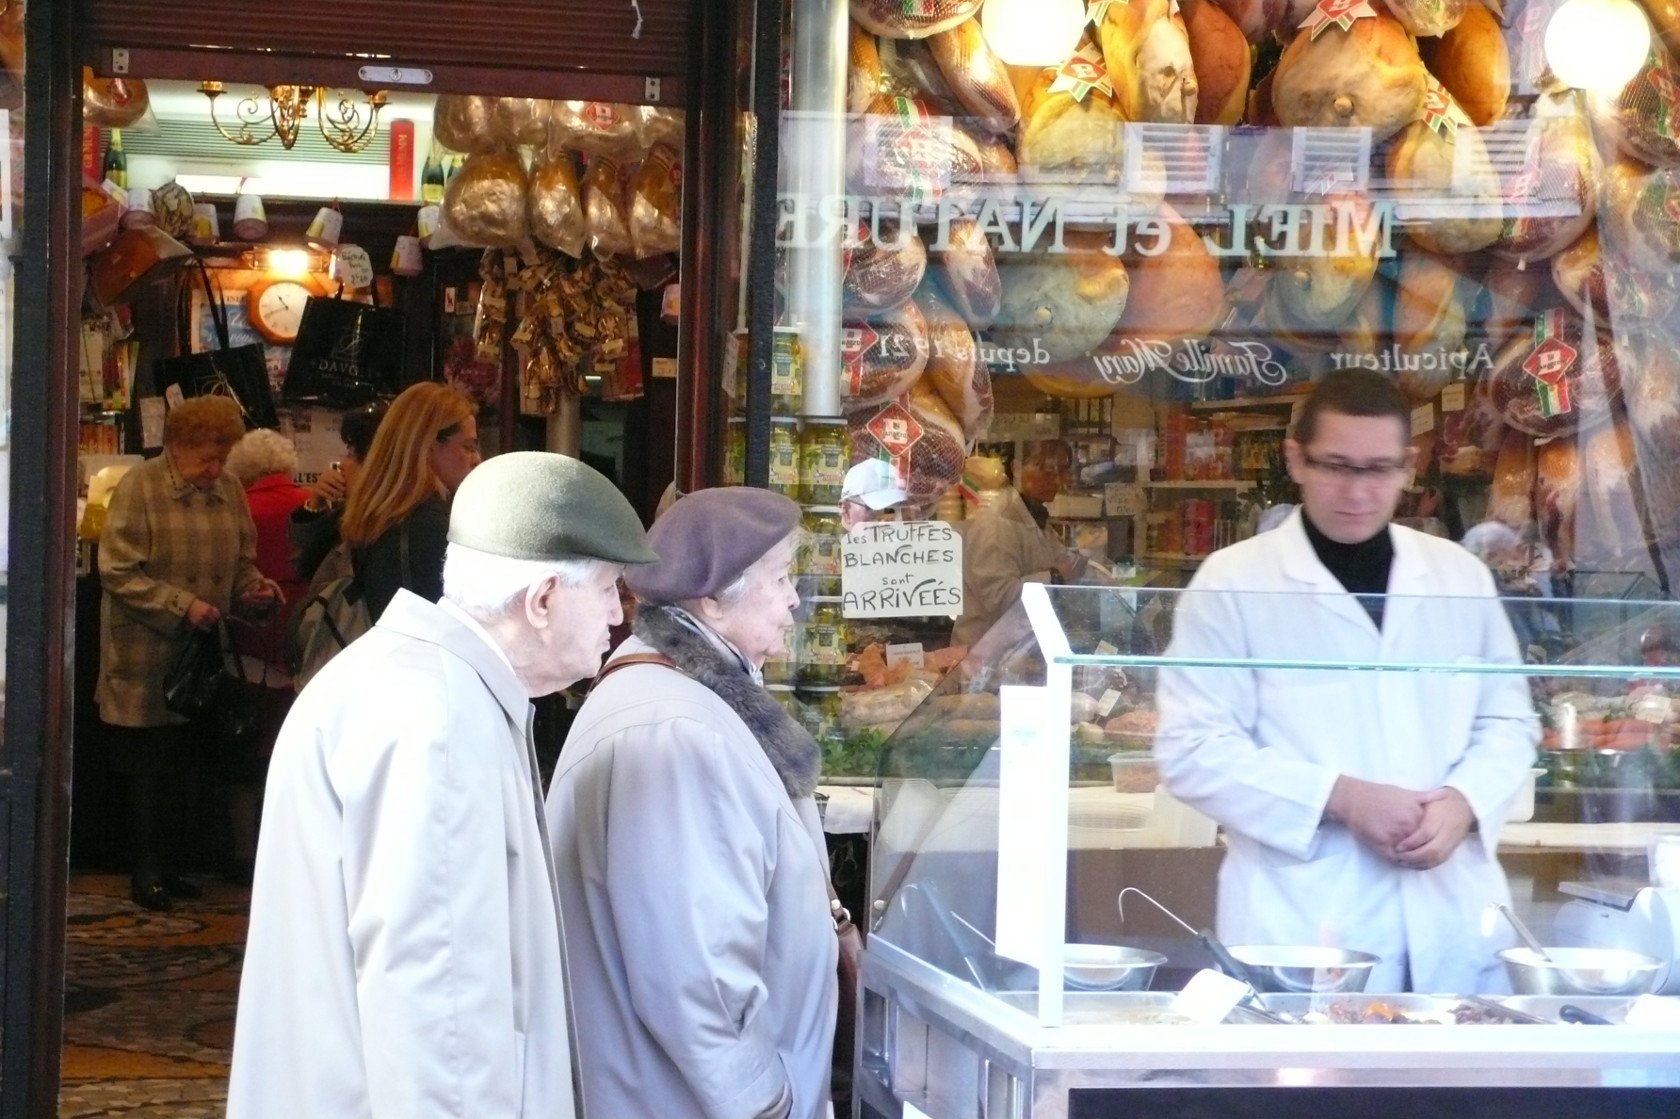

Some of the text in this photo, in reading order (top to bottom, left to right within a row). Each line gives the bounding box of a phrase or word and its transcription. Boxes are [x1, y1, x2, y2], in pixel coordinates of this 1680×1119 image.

[864, 522, 953, 543] TRUFFES
[843, 544, 954, 568] BLANCHES
[882, 573, 915, 586] sont
